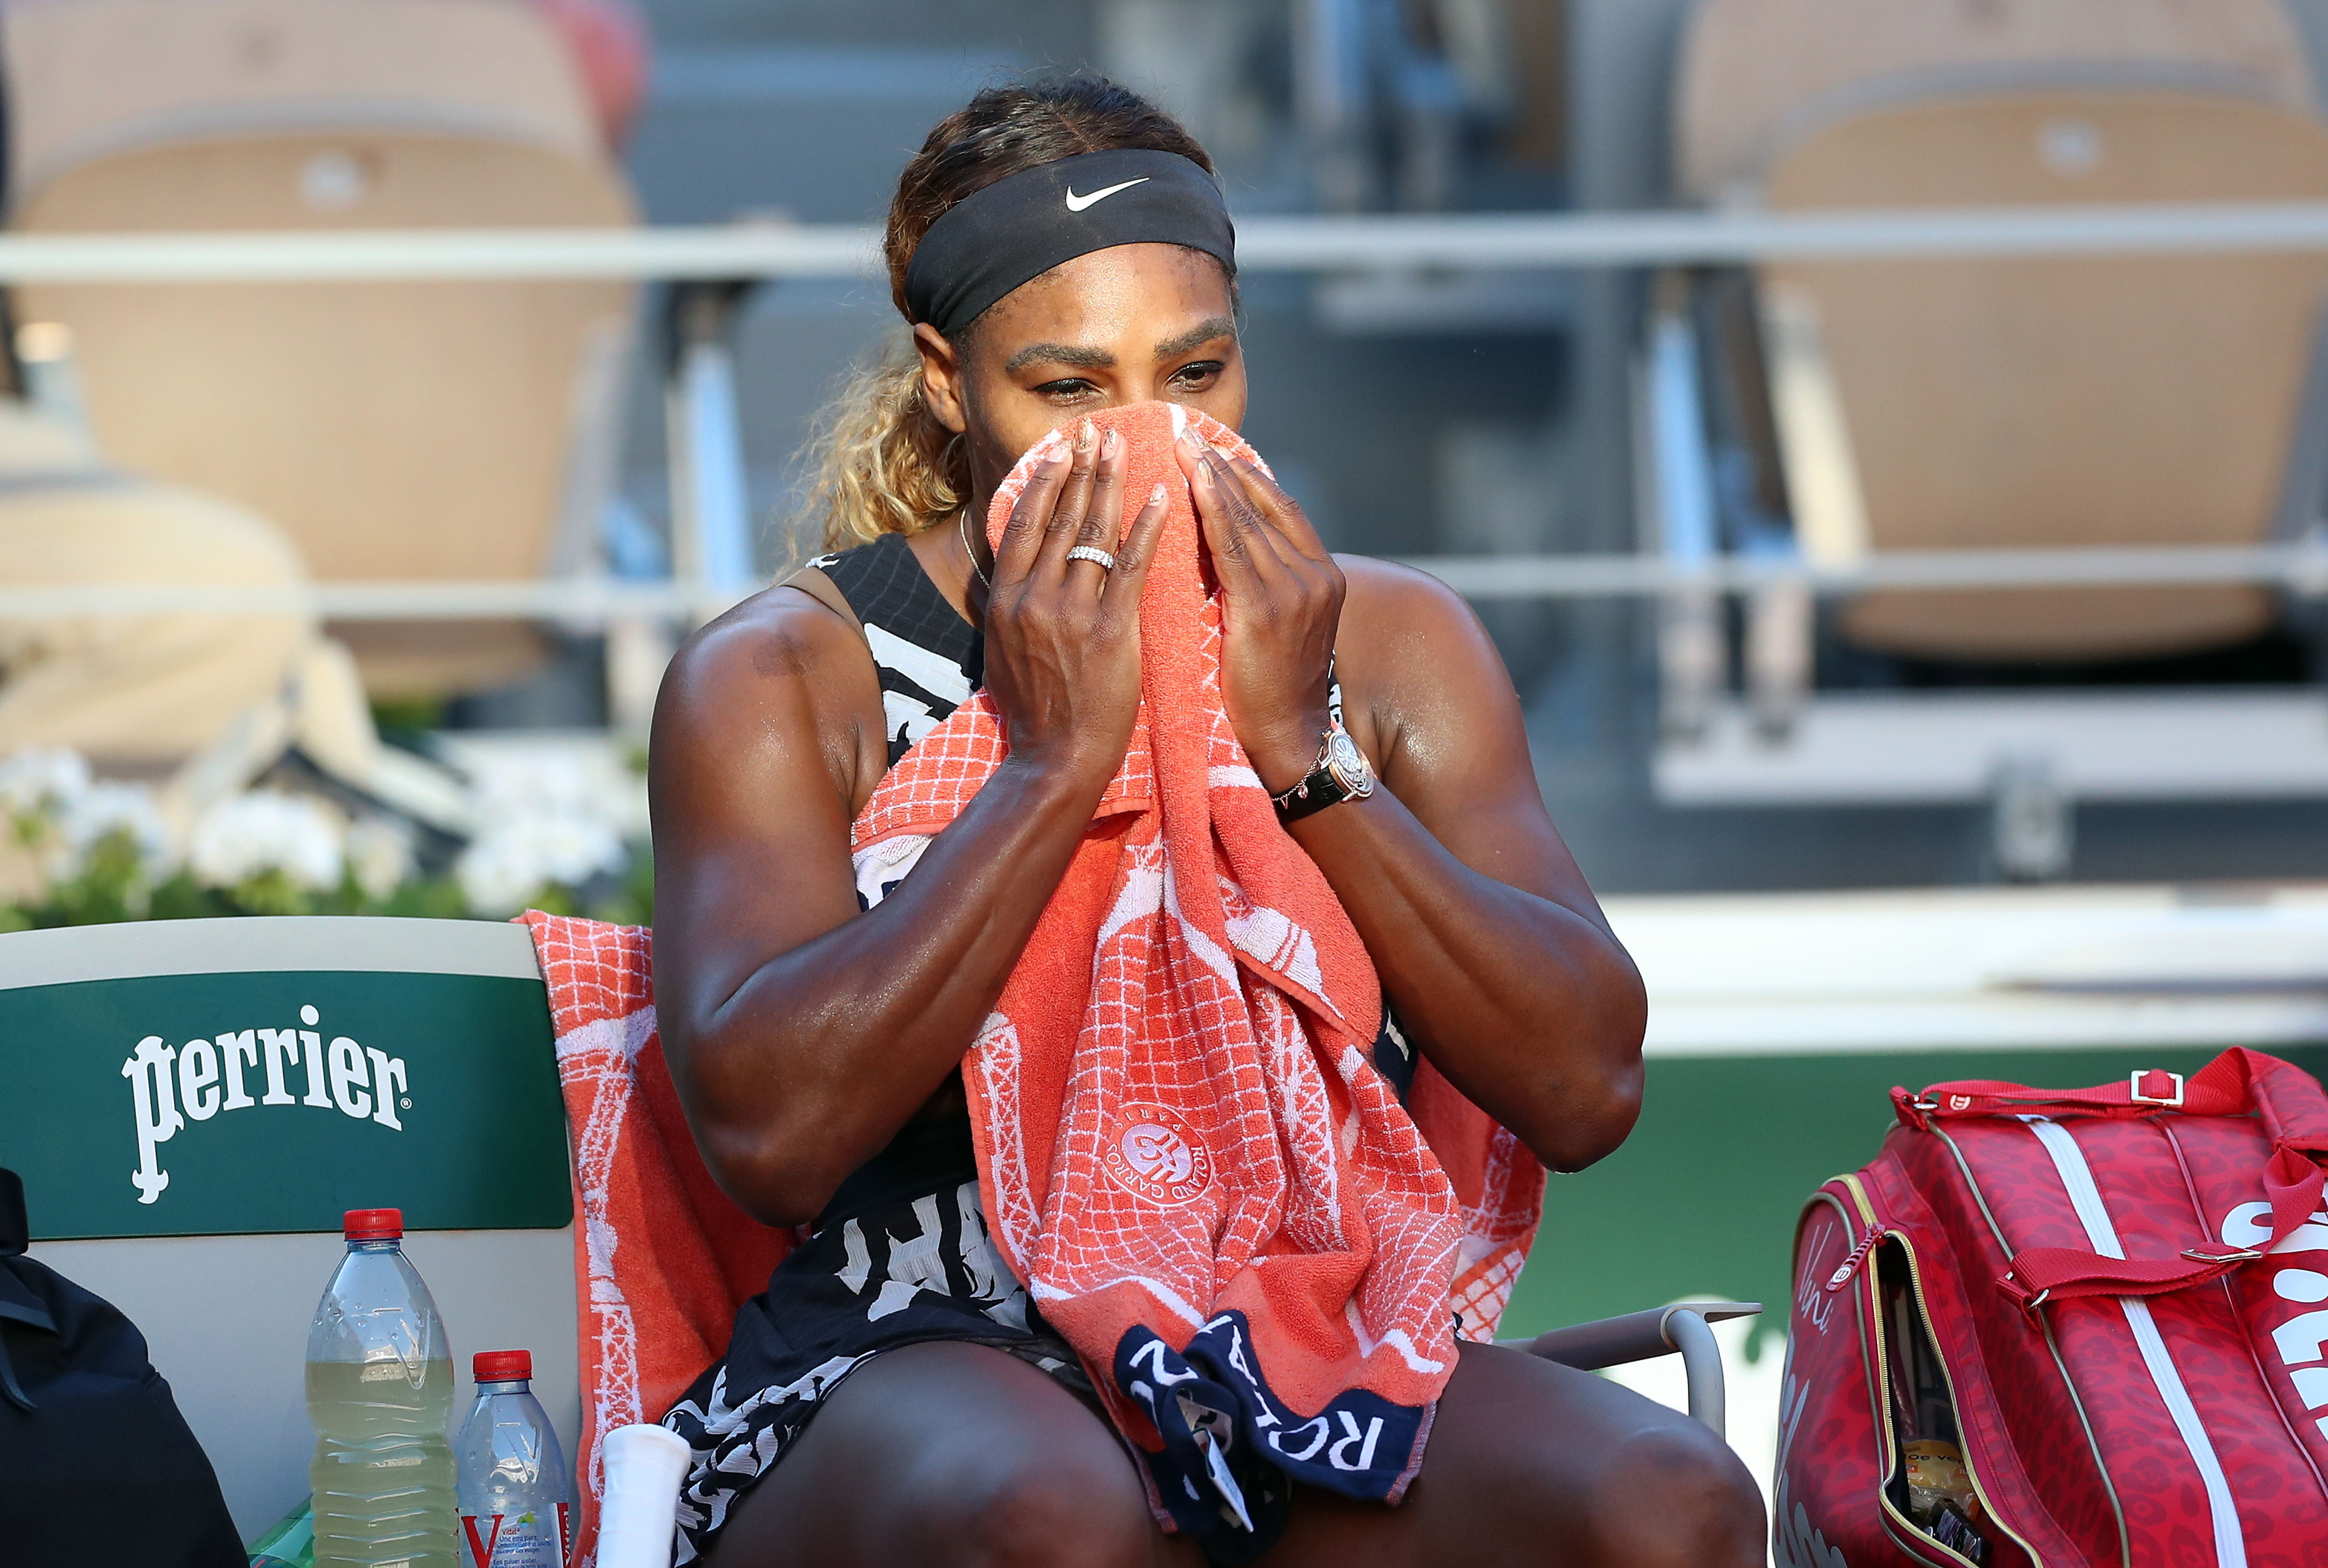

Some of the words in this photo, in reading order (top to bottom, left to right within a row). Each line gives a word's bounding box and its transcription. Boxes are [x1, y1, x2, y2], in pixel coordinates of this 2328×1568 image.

[1114, 1108, 1181, 1131] PARIS
[1106, 1143, 1165, 1199] GARROS
[1171, 1146, 1208, 1200] ROLAND
